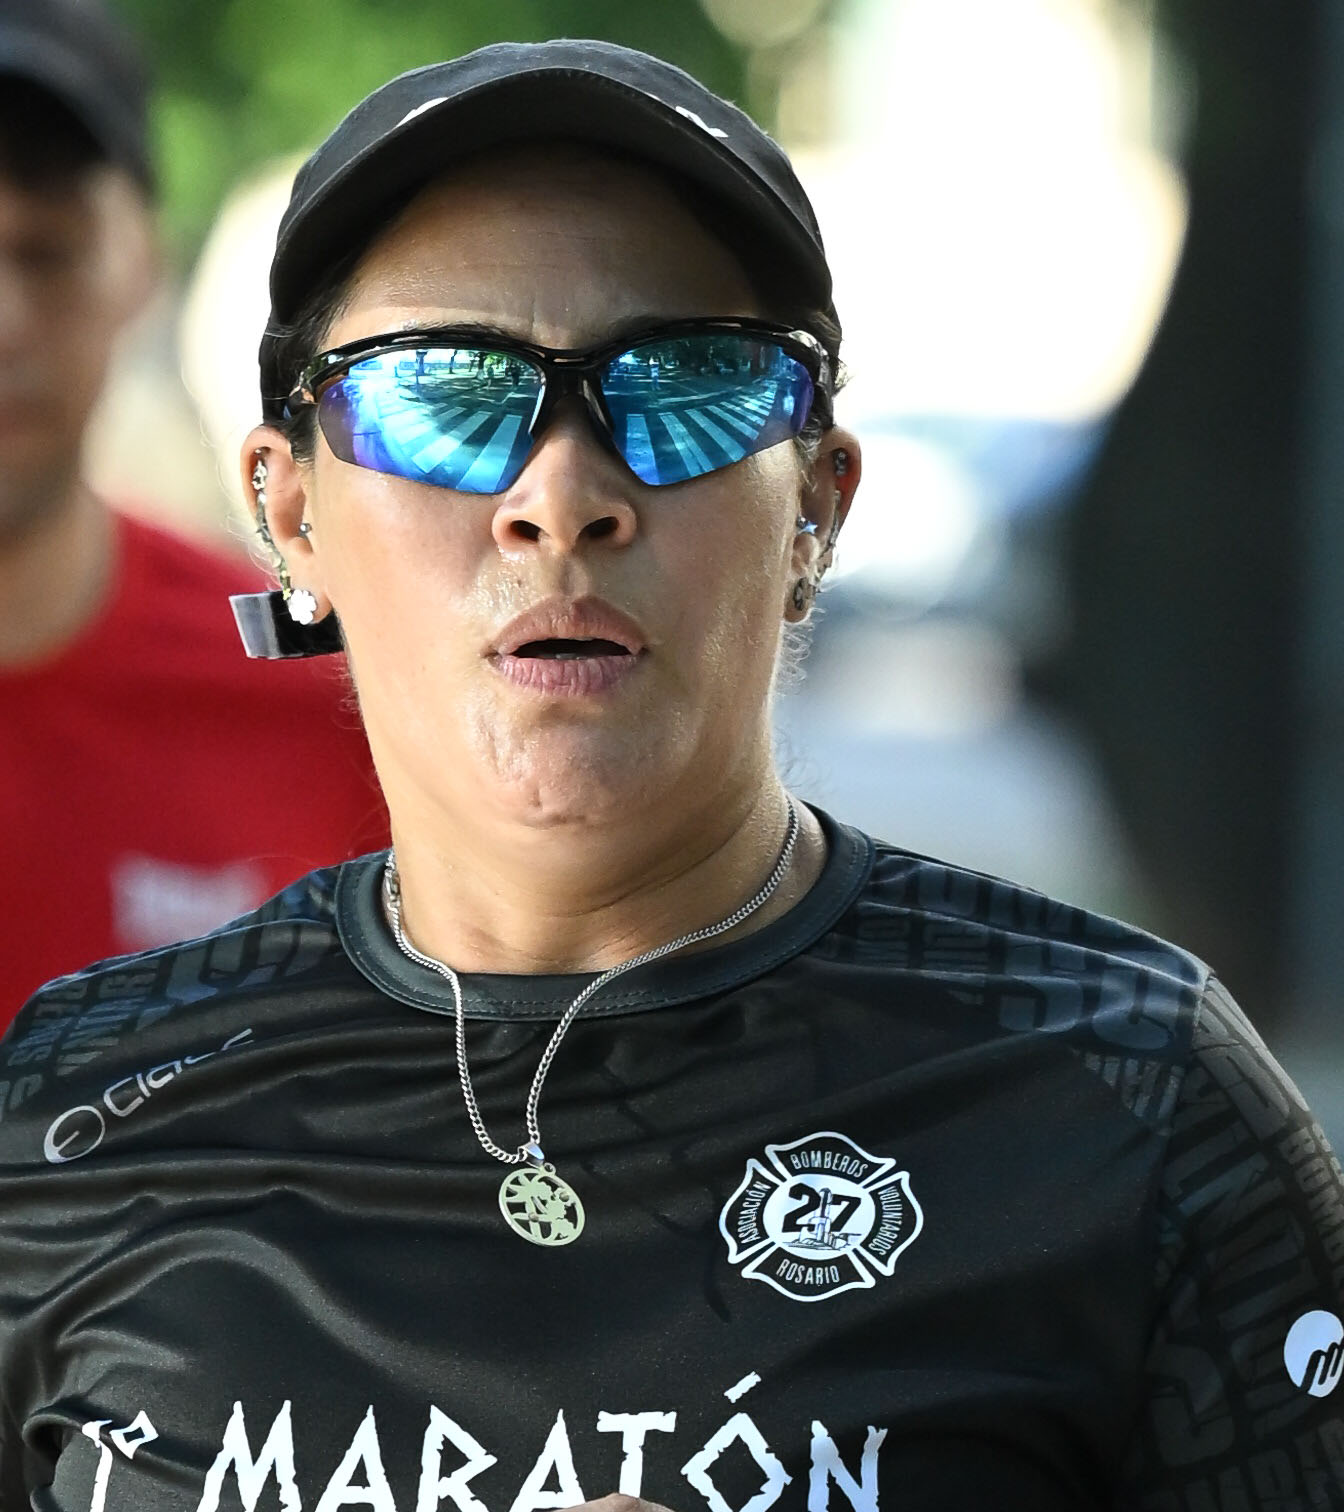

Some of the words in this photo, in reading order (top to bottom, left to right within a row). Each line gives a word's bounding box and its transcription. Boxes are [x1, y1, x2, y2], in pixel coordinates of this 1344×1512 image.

[790, 1150, 869, 1178] BOMBEROS
[737, 1180, 772, 1244] ASOCIACIÓN
[781, 1182, 862, 1234] 27
[868, 1185, 904, 1256] VOLUNTARIOS
[776, 1258, 840, 1285] ROSARIO
